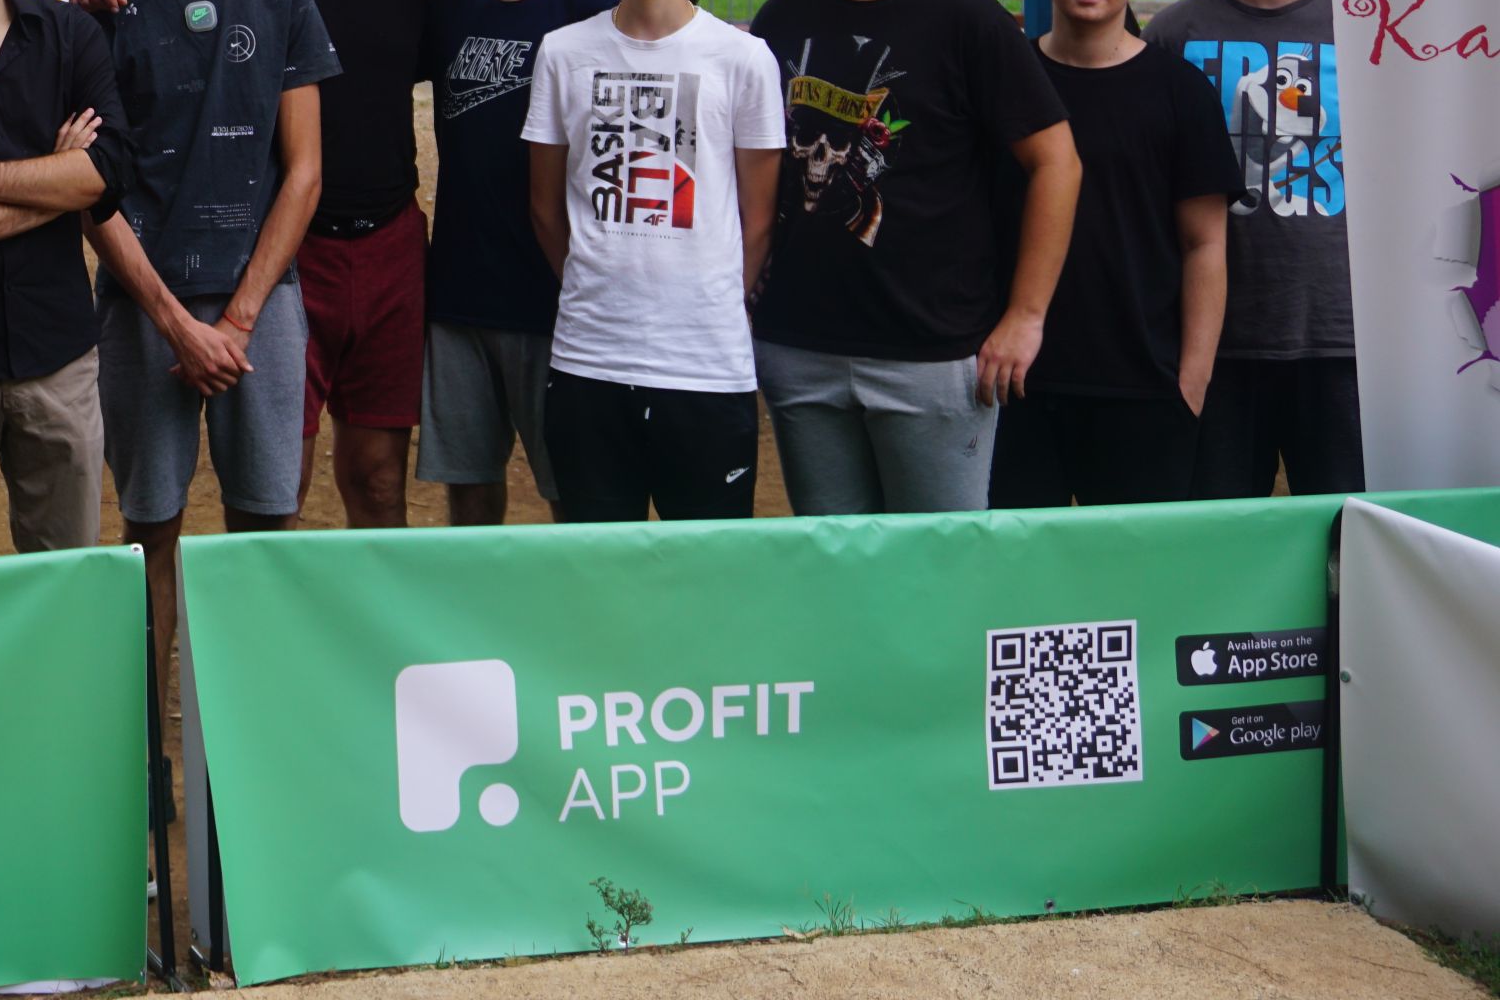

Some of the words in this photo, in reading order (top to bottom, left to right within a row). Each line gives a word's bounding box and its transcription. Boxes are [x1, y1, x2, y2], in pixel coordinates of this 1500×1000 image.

[450, 36, 533, 84] NIKE
[1227, 638, 1277, 651] Available
[1280, 638, 1293, 648] on
[1296, 635, 1313, 646] the
[1227, 655, 1267, 678] App
[1270, 652, 1318, 671] Store
[558, 681, 815, 750] PROFIT
[1231, 716, 1245, 725] Get
[1247, 715, 1252, 724] it
[1253, 715, 1264, 723] on
[1229, 723, 1286, 747] Google
[1290, 722, 1321, 743] play
[558, 761, 691, 822] APP
